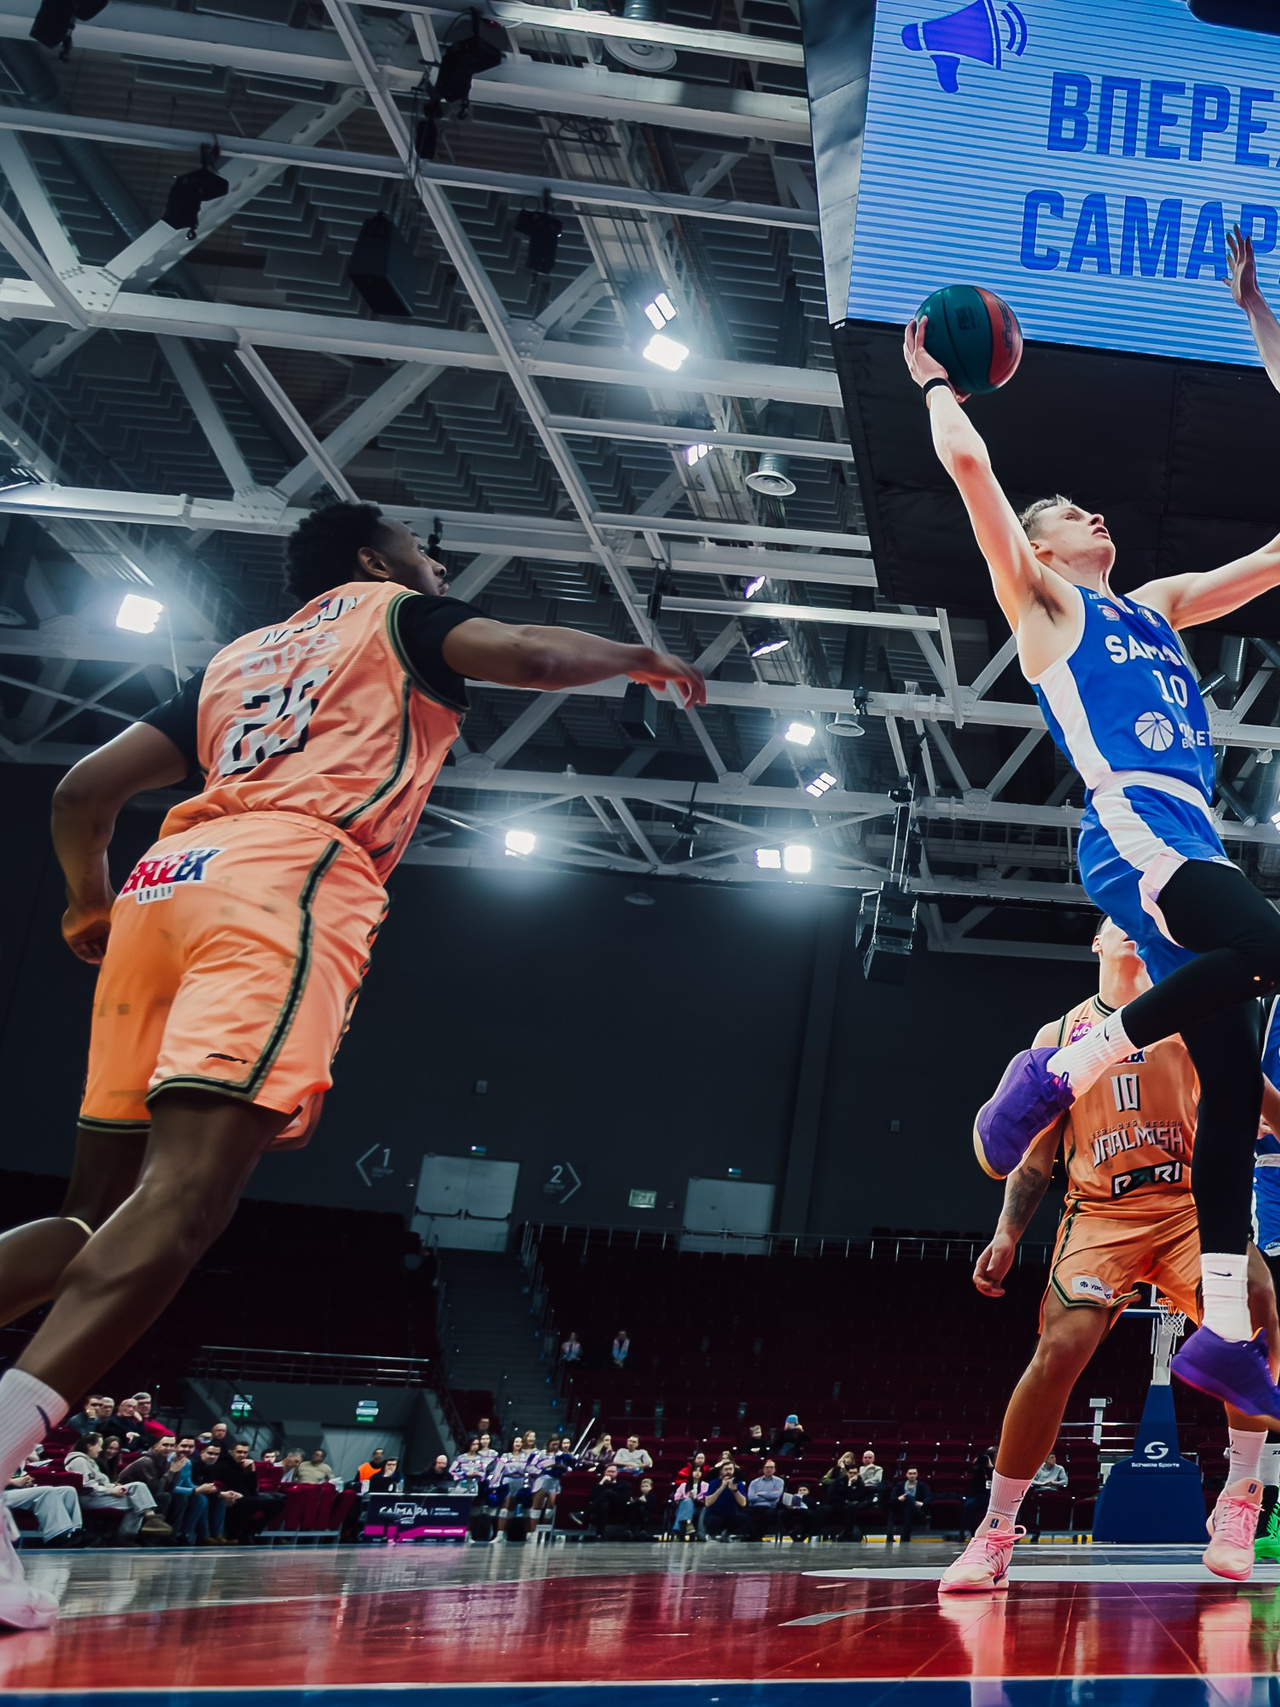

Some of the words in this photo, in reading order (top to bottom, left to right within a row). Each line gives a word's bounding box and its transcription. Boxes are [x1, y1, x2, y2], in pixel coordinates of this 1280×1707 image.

[1152, 670, 1188, 708] 10
[1110, 1073, 1140, 1111] 10
[383, 1148, 391, 1167] 1
[550, 1165, 563, 1183] 2
